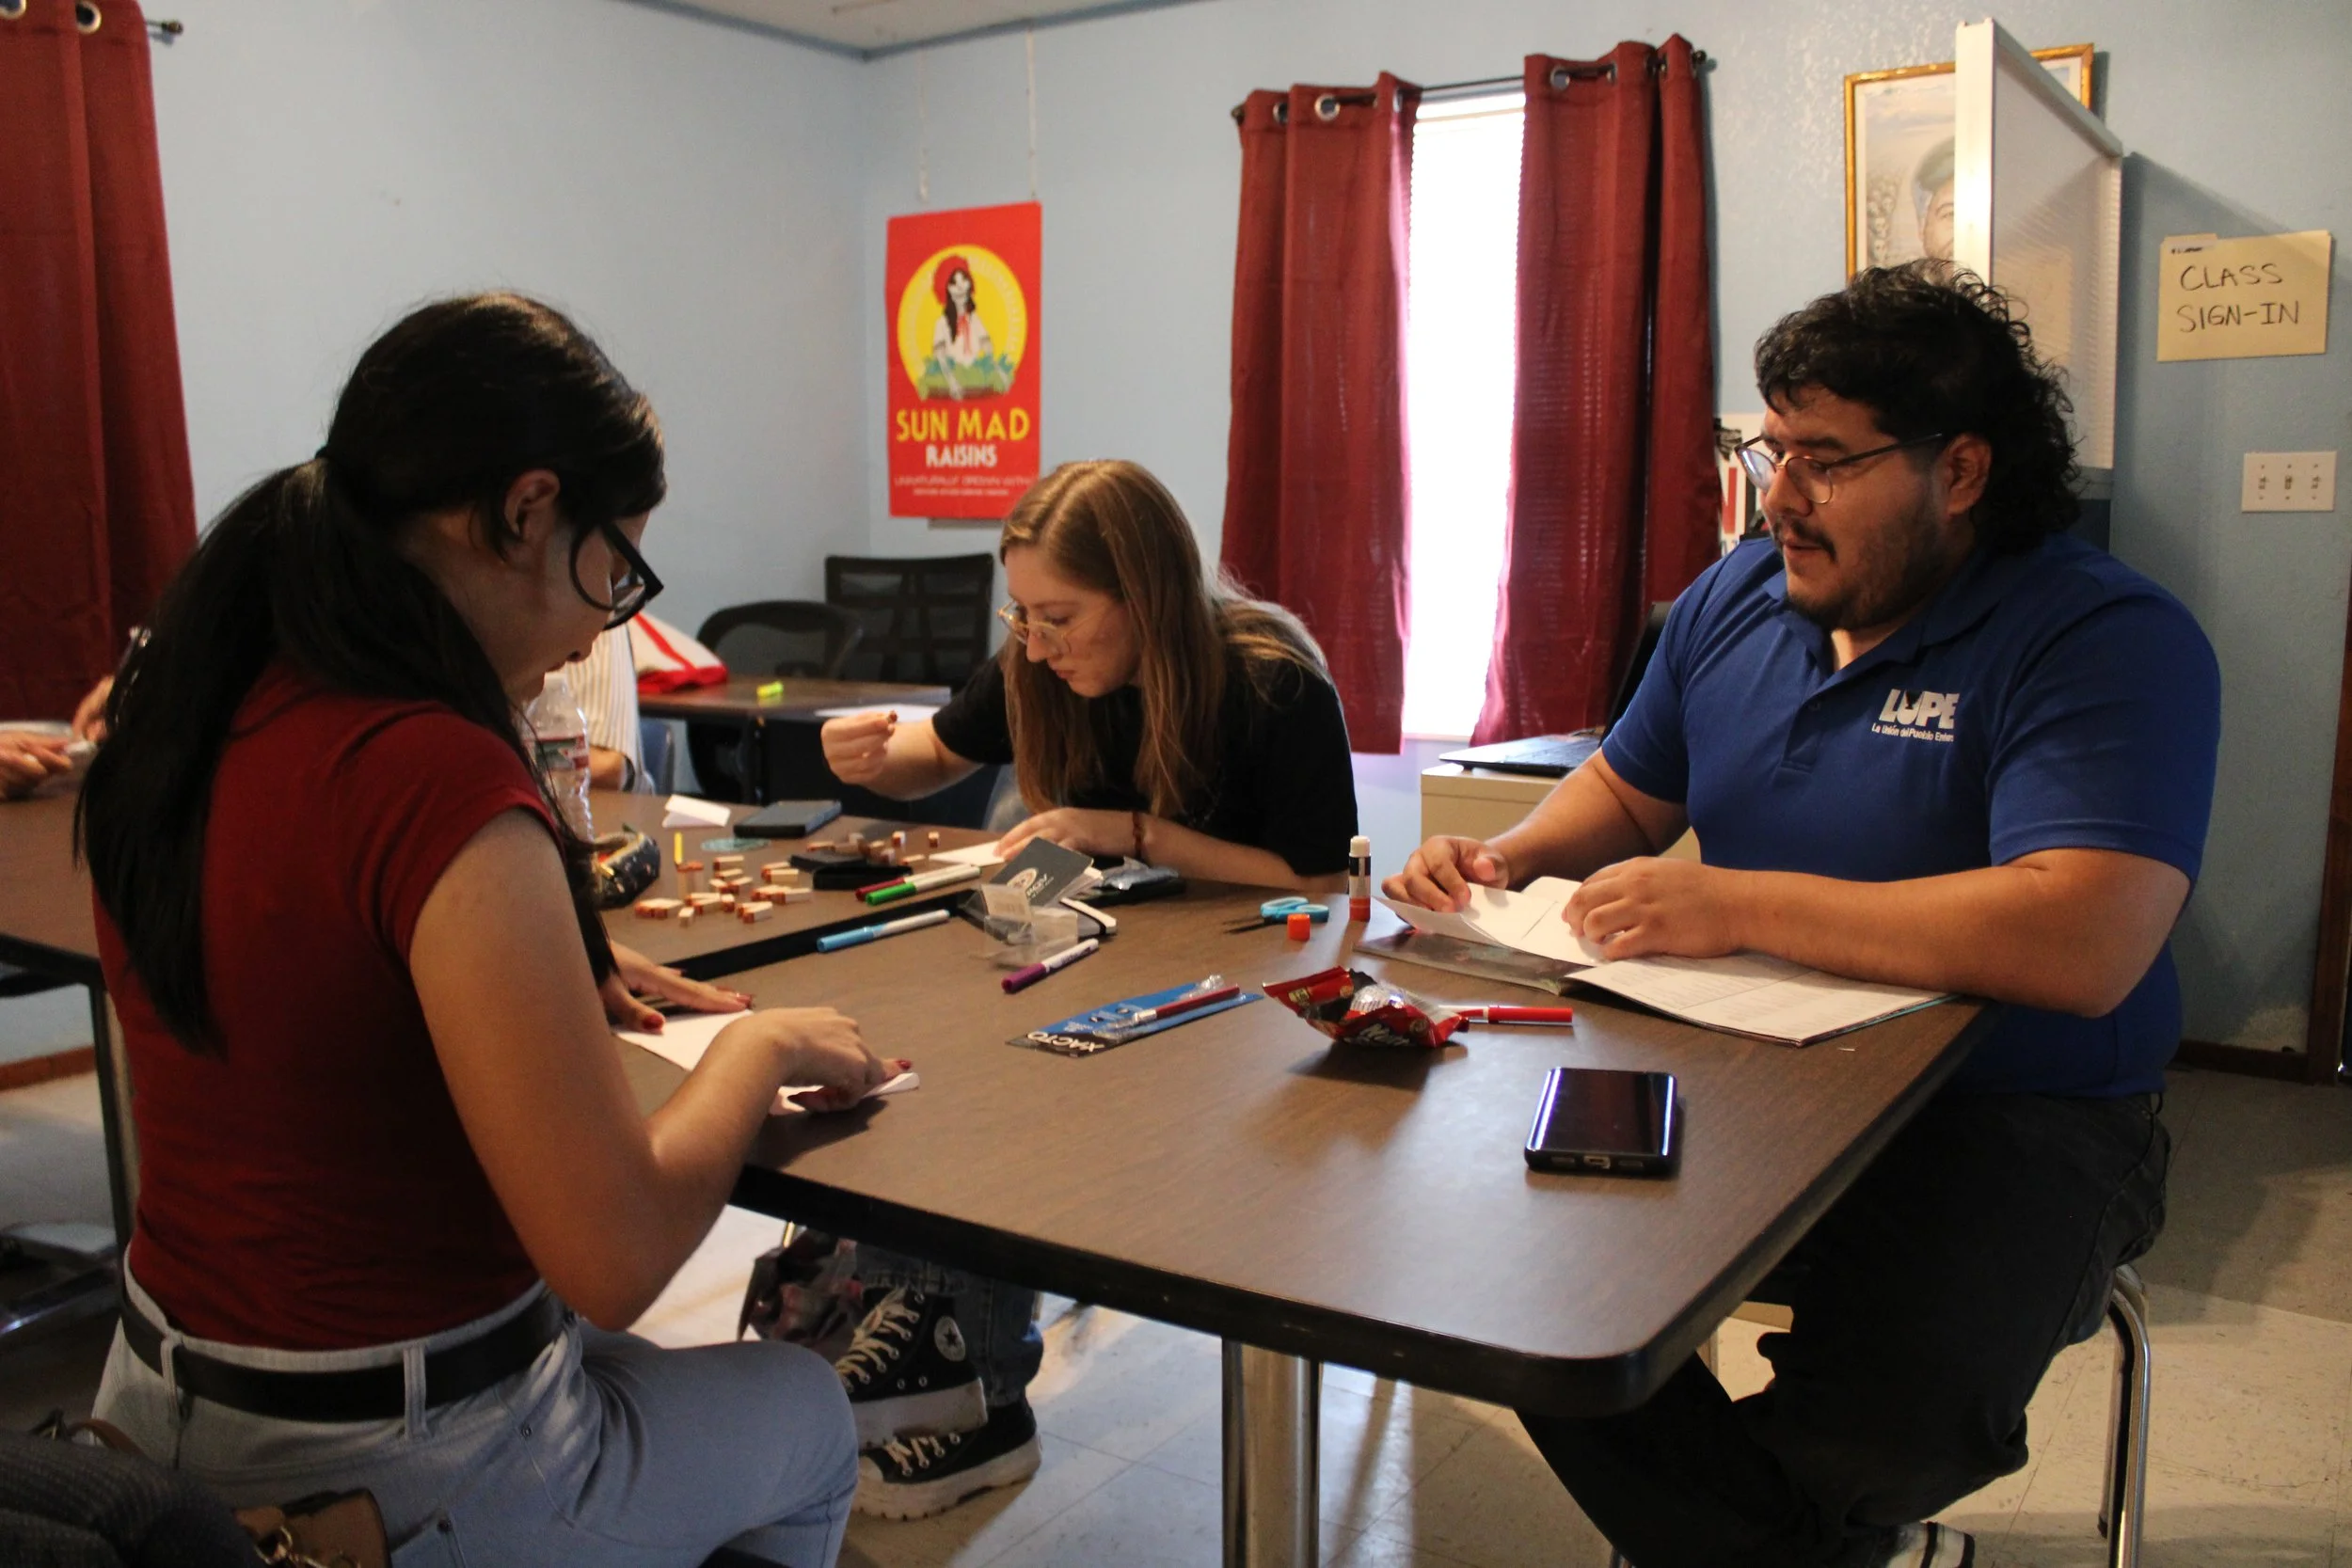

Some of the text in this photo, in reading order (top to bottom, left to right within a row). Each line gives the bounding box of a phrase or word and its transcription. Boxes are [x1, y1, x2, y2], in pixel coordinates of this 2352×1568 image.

[2180, 263, 2282, 292] CLASS
[2176, 300, 2299, 333] SIGN-IN
[896, 406, 1030, 442] SUN MAD
[925, 443, 997, 467] RAISINS
[1879, 689, 1960, 730] LUPE
[1871, 722, 1882, 734] La
